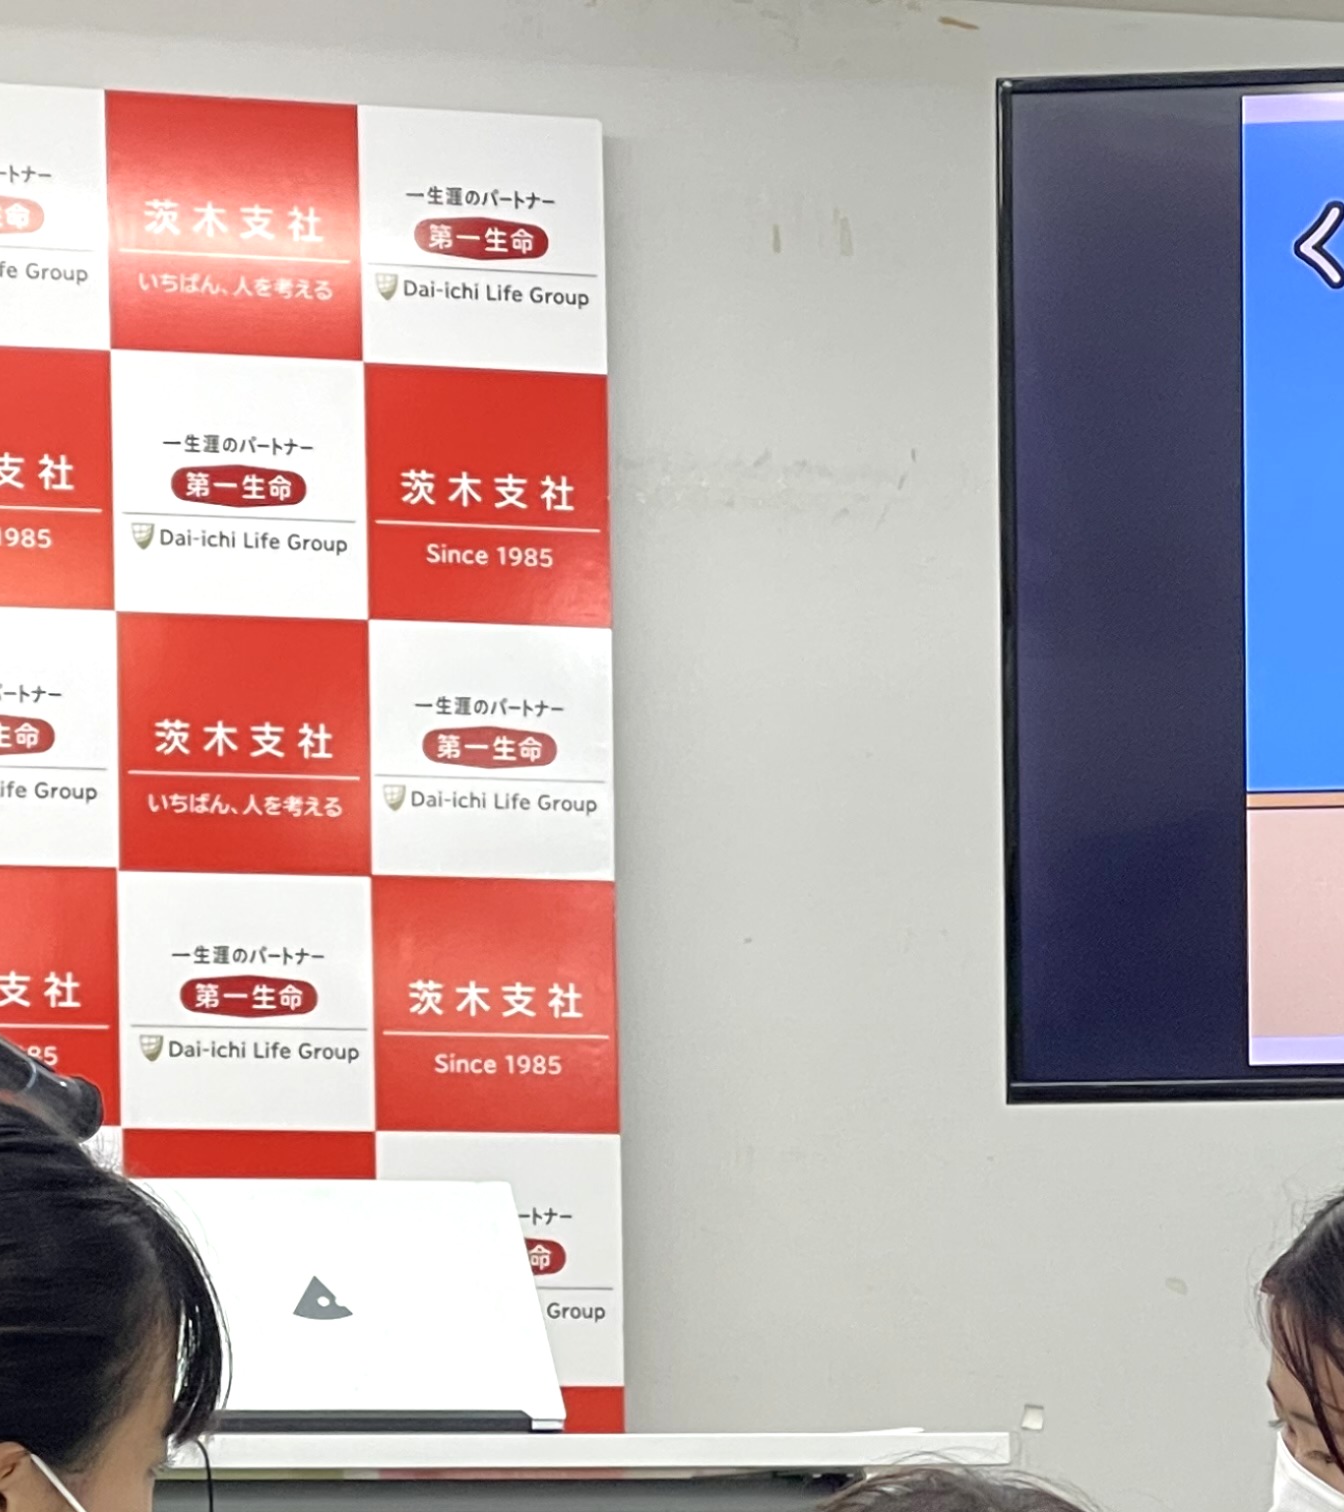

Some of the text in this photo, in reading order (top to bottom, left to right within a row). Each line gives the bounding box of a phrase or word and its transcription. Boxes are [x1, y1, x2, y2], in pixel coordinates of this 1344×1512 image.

[405, 185, 556, 210] 一生涯のパートナー
[143, 198, 325, 248] 茨木支社
[428, 224, 534, 255] 第一生命
[25, 262, 89, 286] Group
[138, 272, 334, 302] いちばん、人を考える
[403, 279, 590, 310] Dai-ichi Life Group
[162, 433, 314, 456] 一生涯のパートナー
[185, 471, 292, 502] 第一生命
[400, 468, 575, 511] 茨木支社
[159, 528, 348, 556] Dai-ichi Life Group
[426, 542, 554, 568] Since 1985
[414, 695, 565, 718] 一生涯のパートナー
[154, 718, 333, 760] 茨木支社
[436, 733, 543, 763] 第一生命
[34, 781, 98, 804] Group
[147, 792, 343, 818] いちばん、人を考える
[410, 790, 598, 817] Dai-ichi Life Group
[171, 945, 325, 966] 一生涯のパートナー
[195, 982, 303, 1011] 第一生命
[408, 979, 584, 1019] 茨木支社
[168, 1040, 360, 1065] Dai-ichi Life Group
[434, 1053, 563, 1076] Since 1985
[546, 1302, 606, 1324] Group
